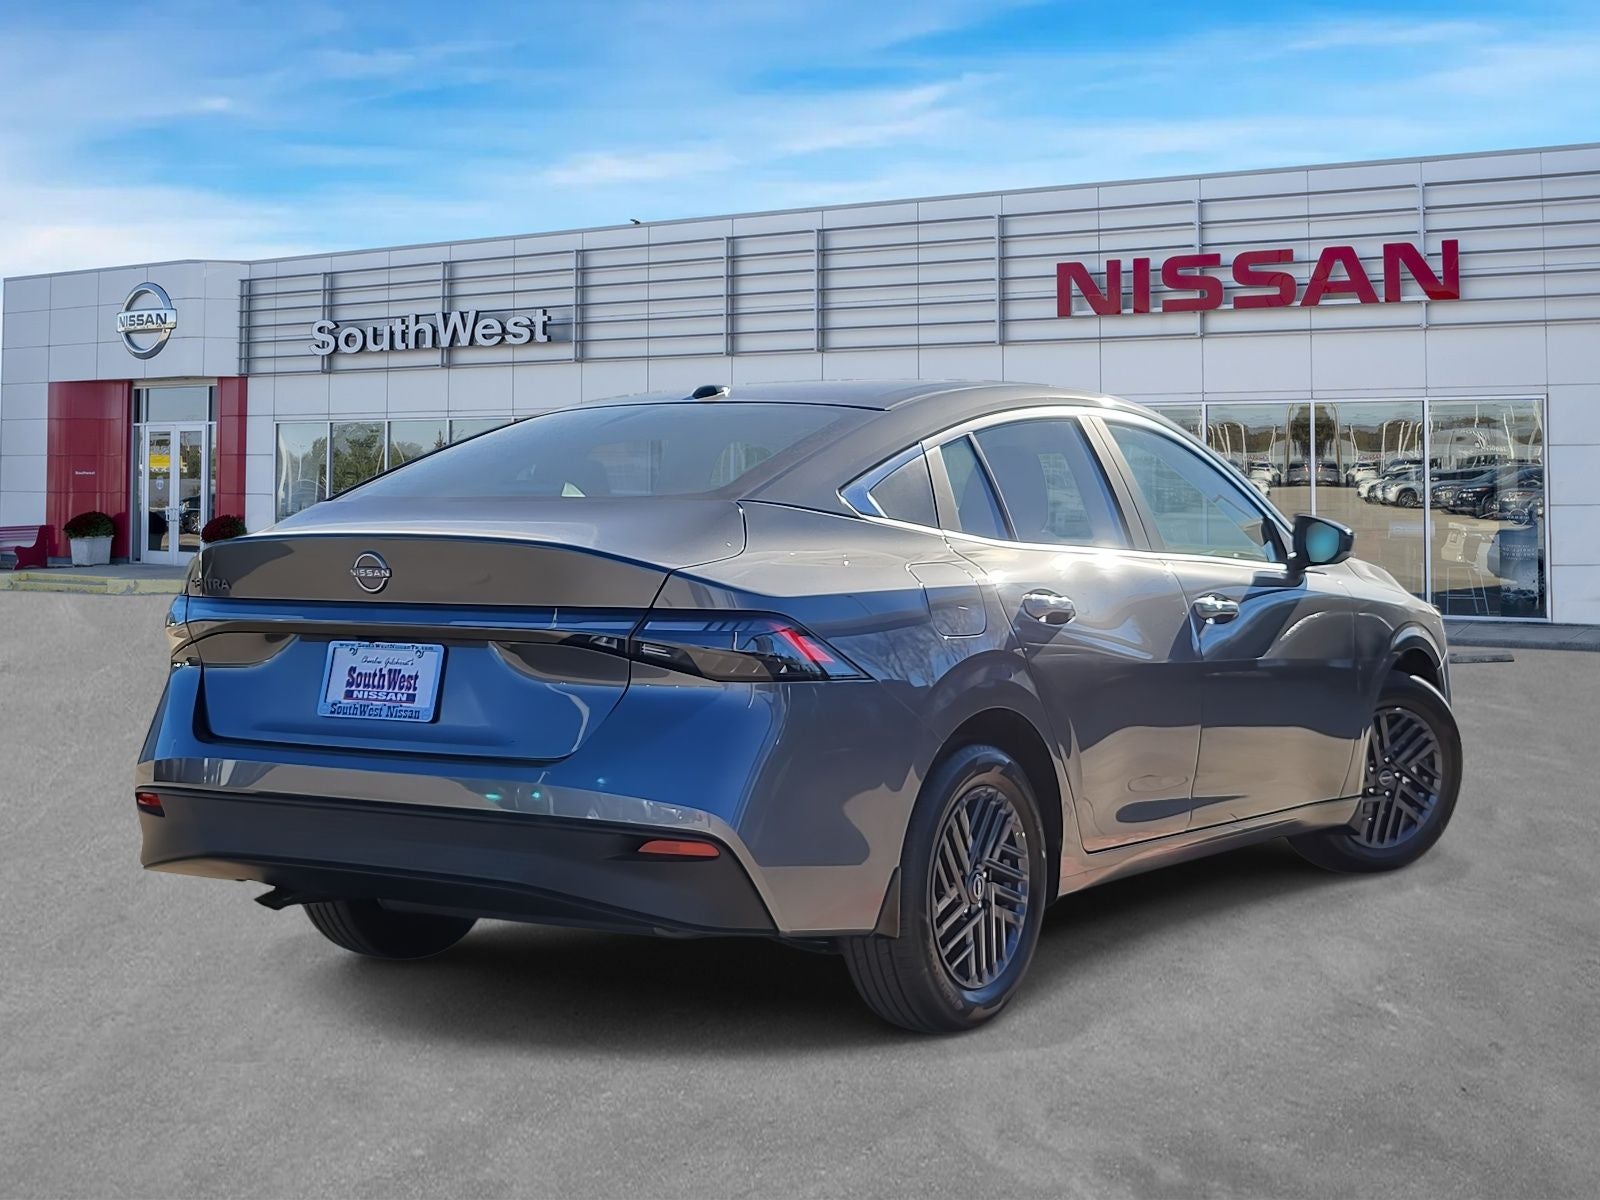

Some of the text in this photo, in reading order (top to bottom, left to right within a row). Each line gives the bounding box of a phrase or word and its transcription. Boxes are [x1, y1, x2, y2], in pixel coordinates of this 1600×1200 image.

[1056, 239, 1461, 319] NISSAN
[118, 312, 168, 328] NISSAN
[310, 309, 552, 356] SouthWest
[350, 568, 391, 577] NISSAN
[345, 665, 420, 692] SouthWest
[352, 690, 408, 701] NISSAN
[329, 701, 421, 720] SouthWest Nissan
